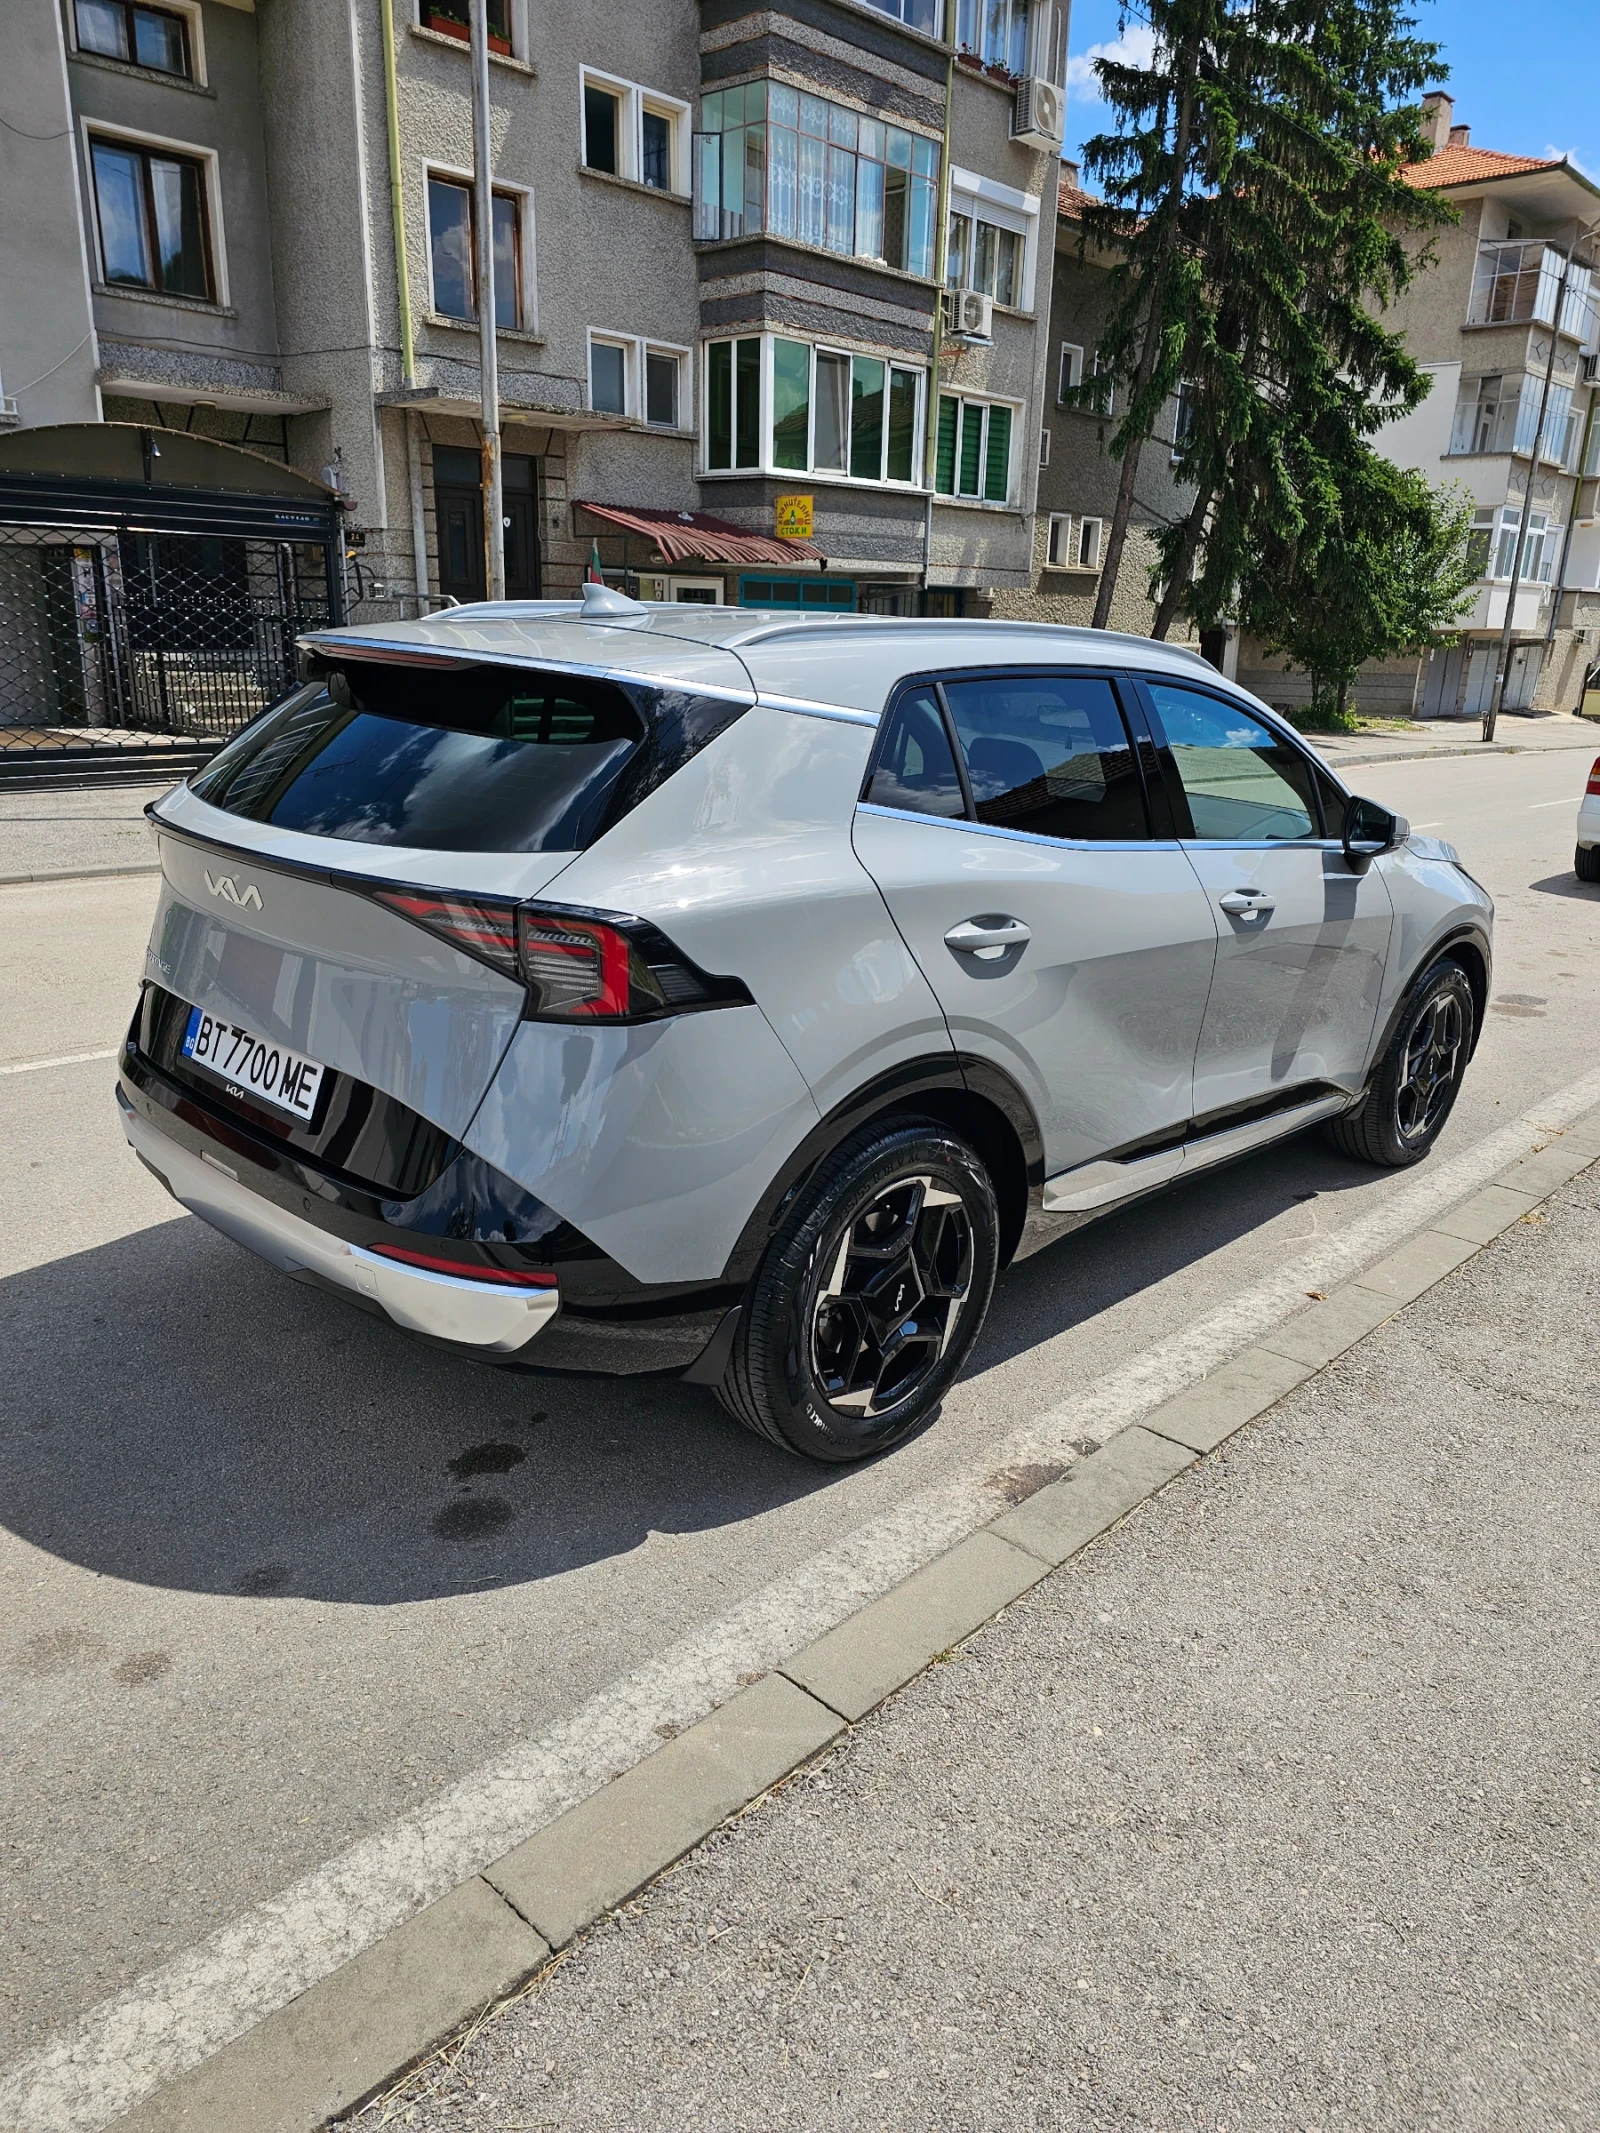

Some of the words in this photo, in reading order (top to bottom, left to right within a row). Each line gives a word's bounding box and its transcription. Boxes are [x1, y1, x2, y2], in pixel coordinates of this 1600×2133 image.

[781, 527, 807, 535] СТОКИ
[185, 1037, 195, 1050] BG
[196, 1015, 228, 1063] BT
[223, 1031, 280, 1091] 7700
[278, 1056, 318, 1111] ME
